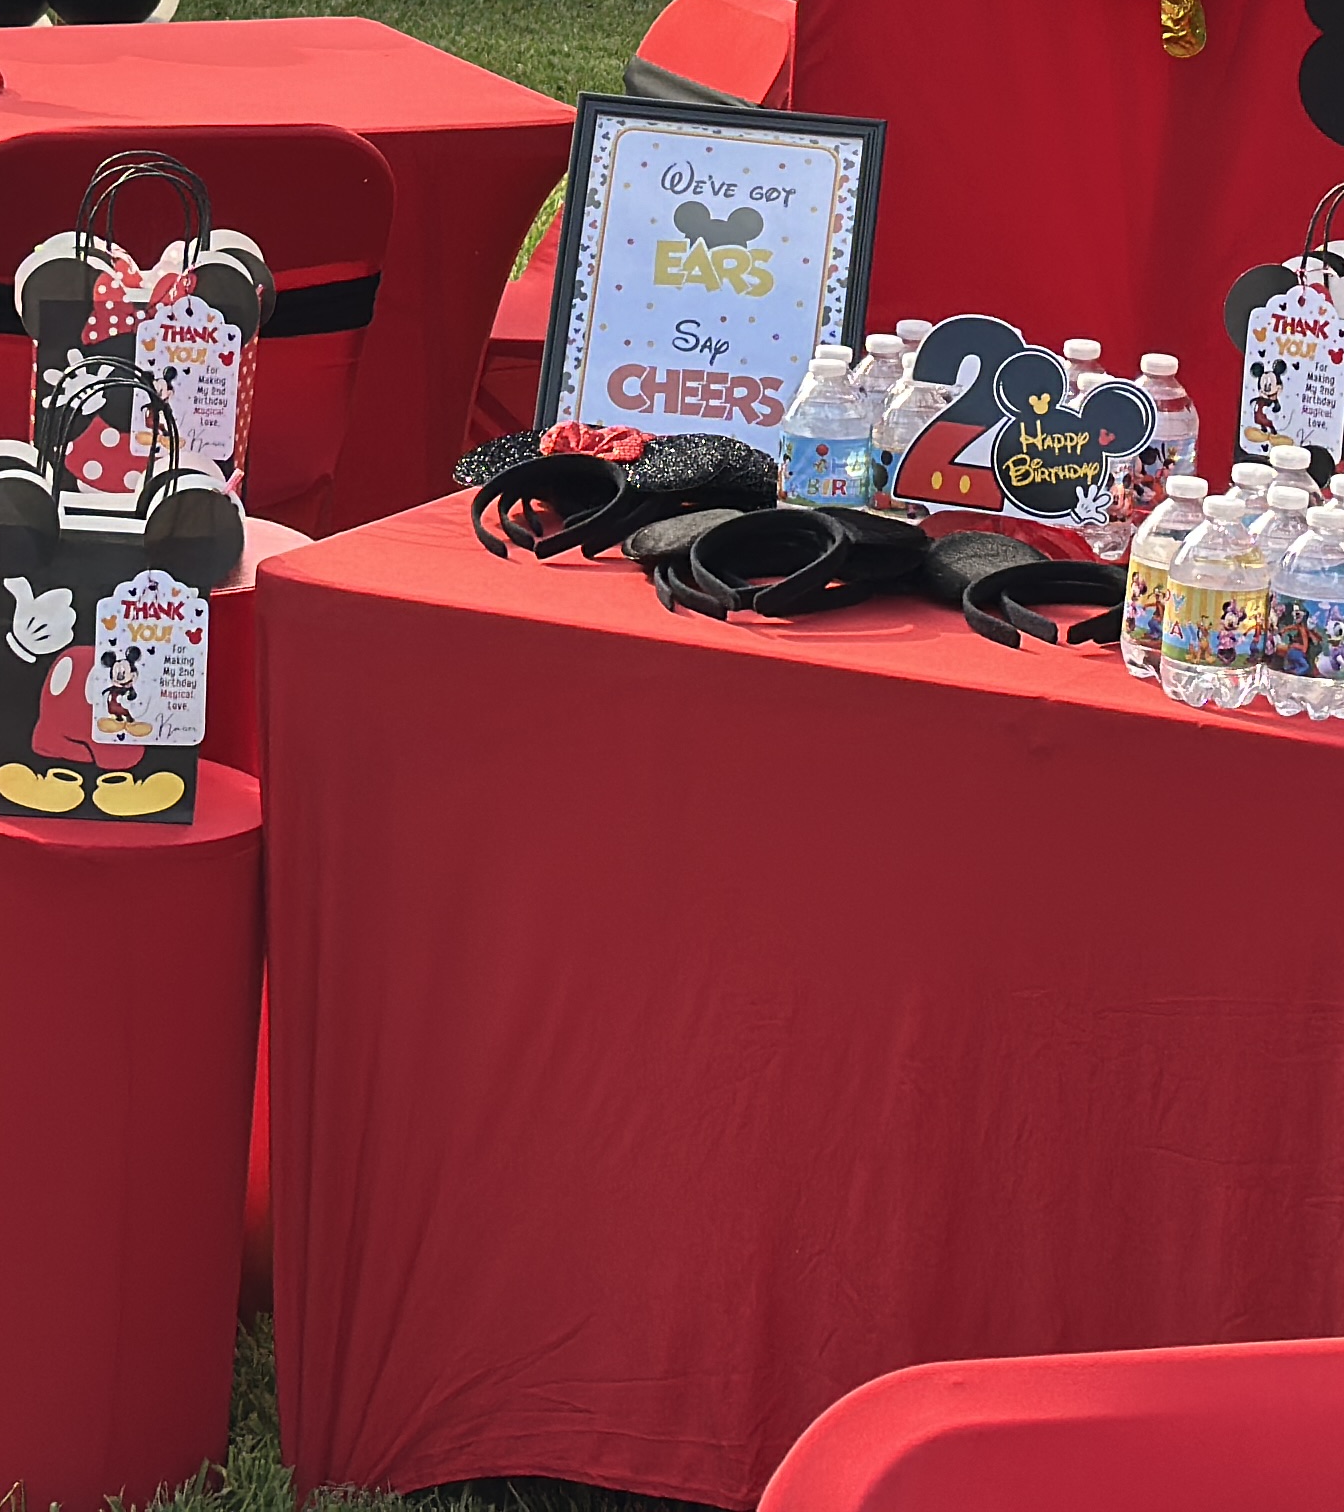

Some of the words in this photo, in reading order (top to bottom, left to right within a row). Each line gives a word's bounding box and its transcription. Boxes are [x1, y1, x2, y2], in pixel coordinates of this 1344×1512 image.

[653, 237, 774, 298] EARS
[160, 324, 218, 344] THANK
[1271, 313, 1330, 340] THANK
[166, 346, 207, 364] YOU!
[1276, 336, 1317, 361] YOU!
[199, 376, 226, 386] Making
[1307, 372, 1335, 385] Making
[197, 387, 208, 396] My
[607, 363, 786, 428] CHEERS
[1305, 383, 1317, 393] My
[1320, 386, 1335, 396] 2nd
[194, 396, 227, 407] Birthday
[1302, 393, 1336, 409] Birthday
[893, 314, 1025, 513] 2
[121, 600, 185, 620] THANK
[127, 623, 173, 643] YOU!
[164, 656, 194, 665] Making
[162, 667, 175, 677] My
[179, 668, 194, 676] 2nd
[159, 677, 197, 688] Birthday
